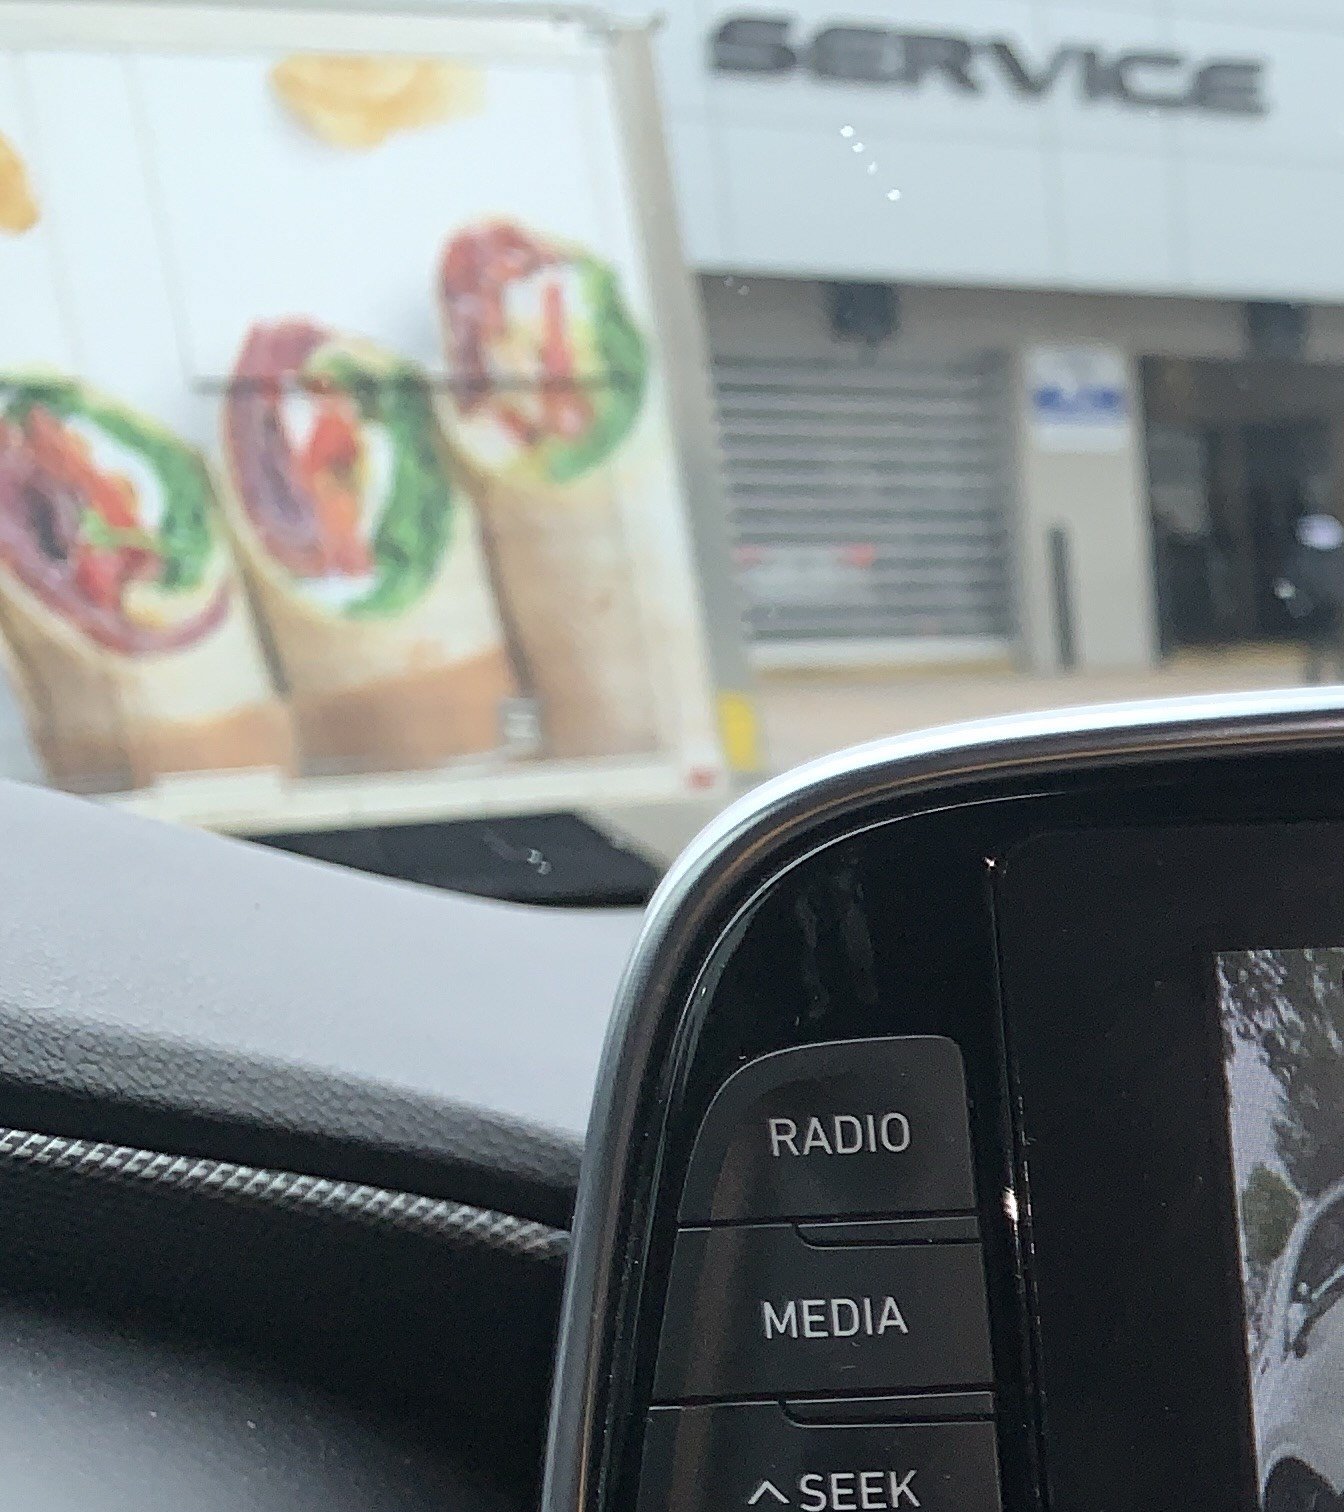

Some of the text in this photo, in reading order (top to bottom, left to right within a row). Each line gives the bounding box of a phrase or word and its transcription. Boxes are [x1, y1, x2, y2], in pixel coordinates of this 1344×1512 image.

[712, 17, 1268, 116] SERVICE
[768, 1112, 912, 1157] RADIO
[762, 1296, 909, 1340] MEDIA
[799, 1469, 922, 1512] SEEK
